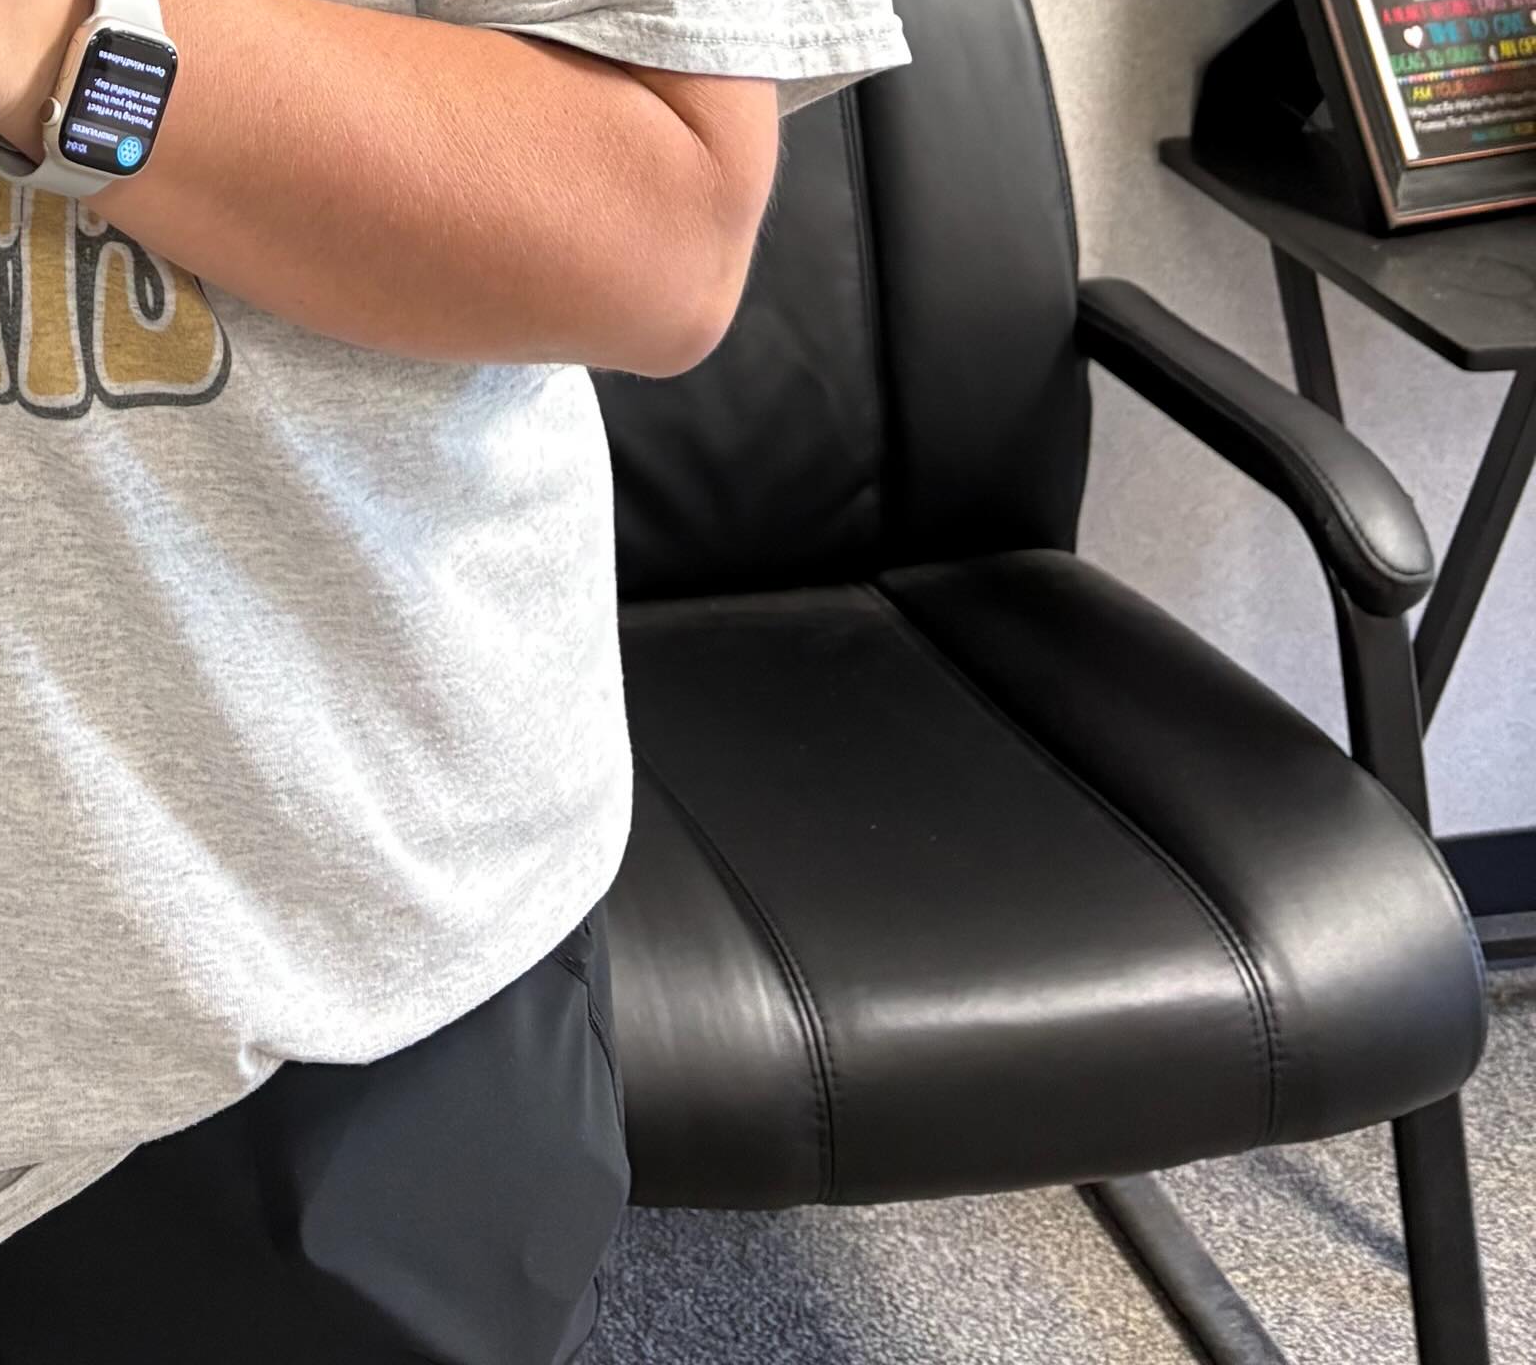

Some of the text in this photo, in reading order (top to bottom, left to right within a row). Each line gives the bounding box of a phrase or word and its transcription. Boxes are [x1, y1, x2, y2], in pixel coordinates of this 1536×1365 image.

[98, 50, 166, 77] Open Mindfulness
[91, 91, 110, 103] have
[94, 77, 161, 104] more mindful day.
[110, 98, 124, 108] you
[125, 100, 141, 113] help
[142, 105, 157, 116] can
[86, 102, 154, 129] Pausing to reflect
[72, 123, 118, 143] MINDFULNESS
